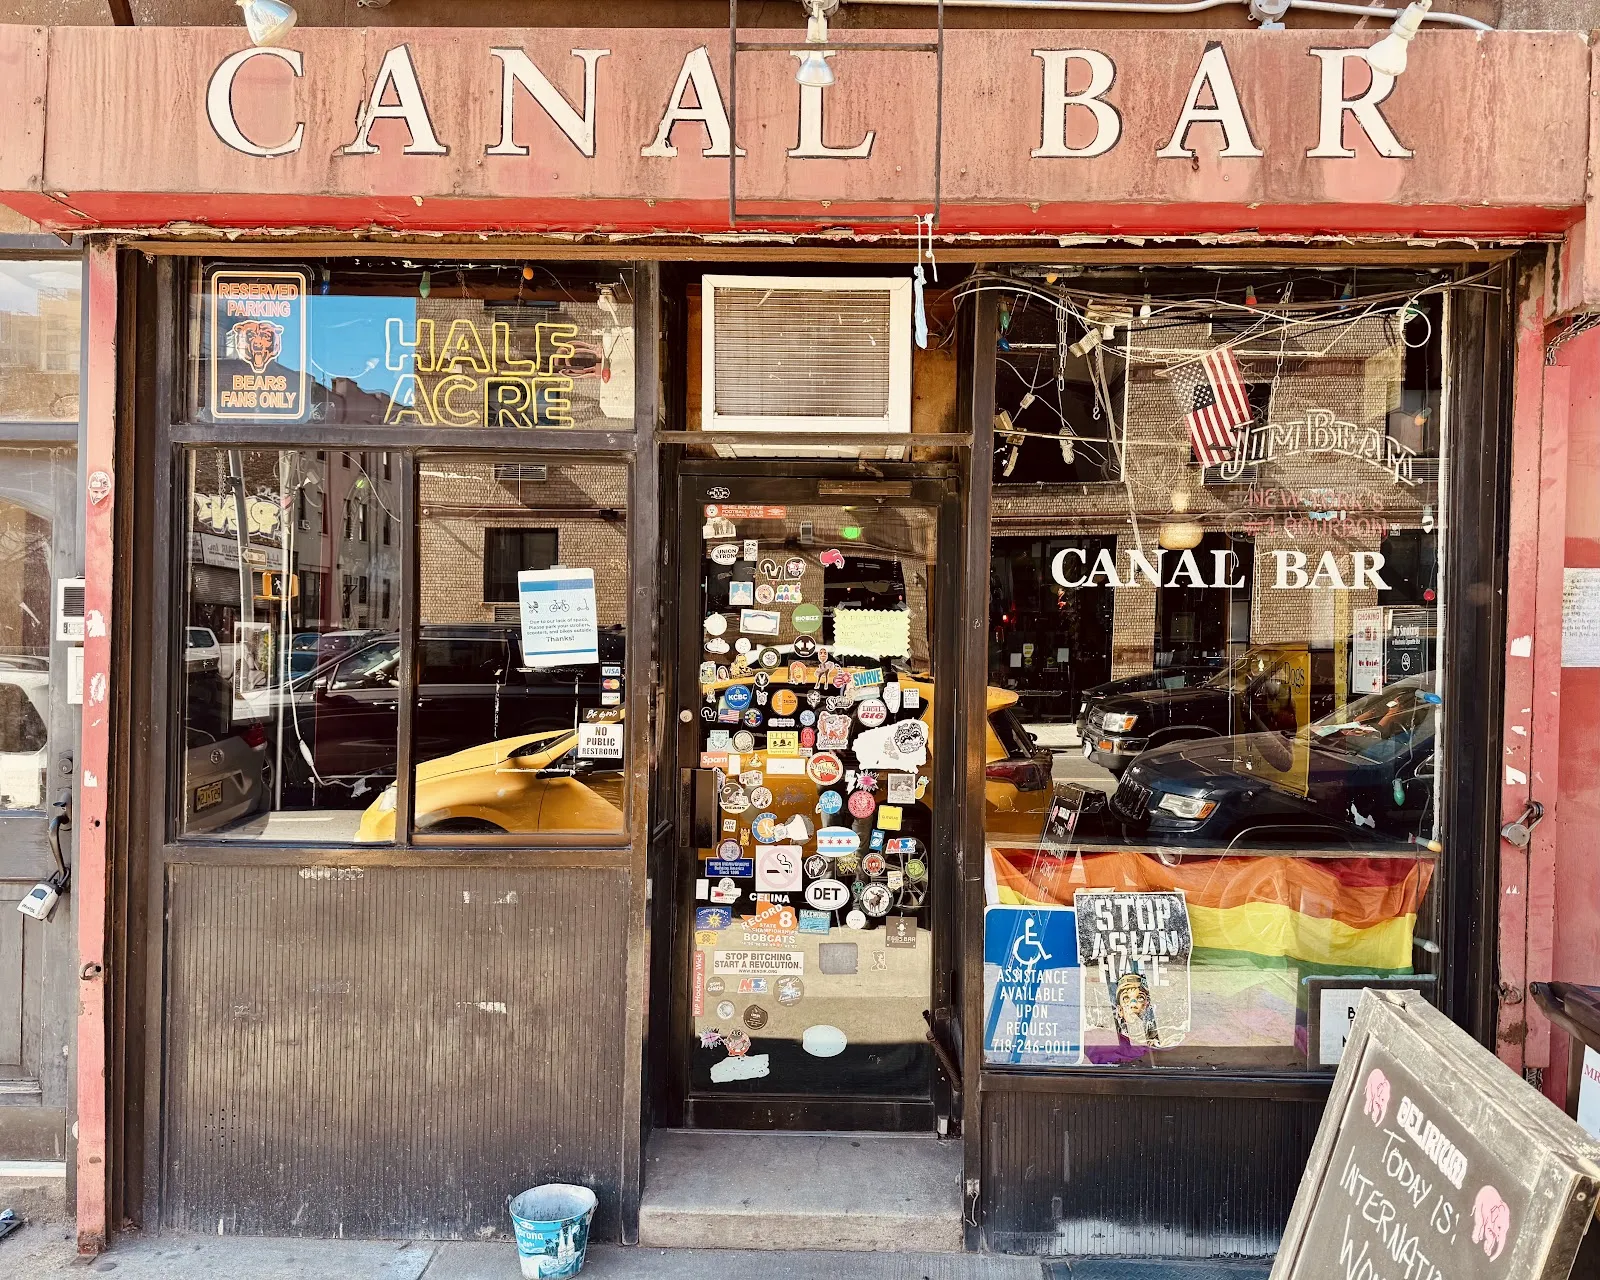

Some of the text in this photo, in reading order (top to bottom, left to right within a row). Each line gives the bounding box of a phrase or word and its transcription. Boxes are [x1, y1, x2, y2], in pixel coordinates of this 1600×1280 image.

[206, 41, 1416, 159] CANAL BAR
[218, 283, 298, 299] RESERVED
[227, 300, 291, 317] PARKING
[385, 317, 578, 376] HALF
[232, 375, 287, 391] BEARS
[221, 391, 296, 409] FANS ONLY
[384, 374, 574, 430] ACRE
[1221, 408, 1416, 487] JIM BEAM
[1250, 488, 1299, 509] NEW
[1284, 517, 1387, 538] BOURBON
[1051, 547, 1392, 590] CANAL BAR
[1358, 612, 1380, 621] CHOKING
[1400, 624, 1420, 637] Smoking
[853, 670, 883, 687] SWRVE
[595, 726, 608, 736] NO
[586, 738, 616, 747] PUBLIC
[582, 748, 619, 756] RESTROOM
[702, 755, 728, 766] Spam
[749, 892, 790, 903] CELINA
[813, 888, 841, 901] DET
[740, 904, 783, 930] RECORD
[779, 911, 792, 928] 8
[1094, 898, 1171, 931] STOP
[743, 933, 796, 944] BOBCATS
[1090, 930, 1180, 960] ASIAN
[714, 960, 740, 968] START
[725, 952, 792, 961] STOP BITCHING
[997, 969, 1068, 984] ASSISTANCE
[1098, 953, 1170, 987] HATE
[1000, 986, 1064, 1002] AVAILABLE
[1016, 1004, 1048, 1019] UPON
[1006, 1022, 1058, 1036] REQUEST
[993, 1039, 1070, 1054] 718-246-0011
[1381, 1128, 1433, 1209] TODAY
[515, 1224, 544, 1240] Corona
